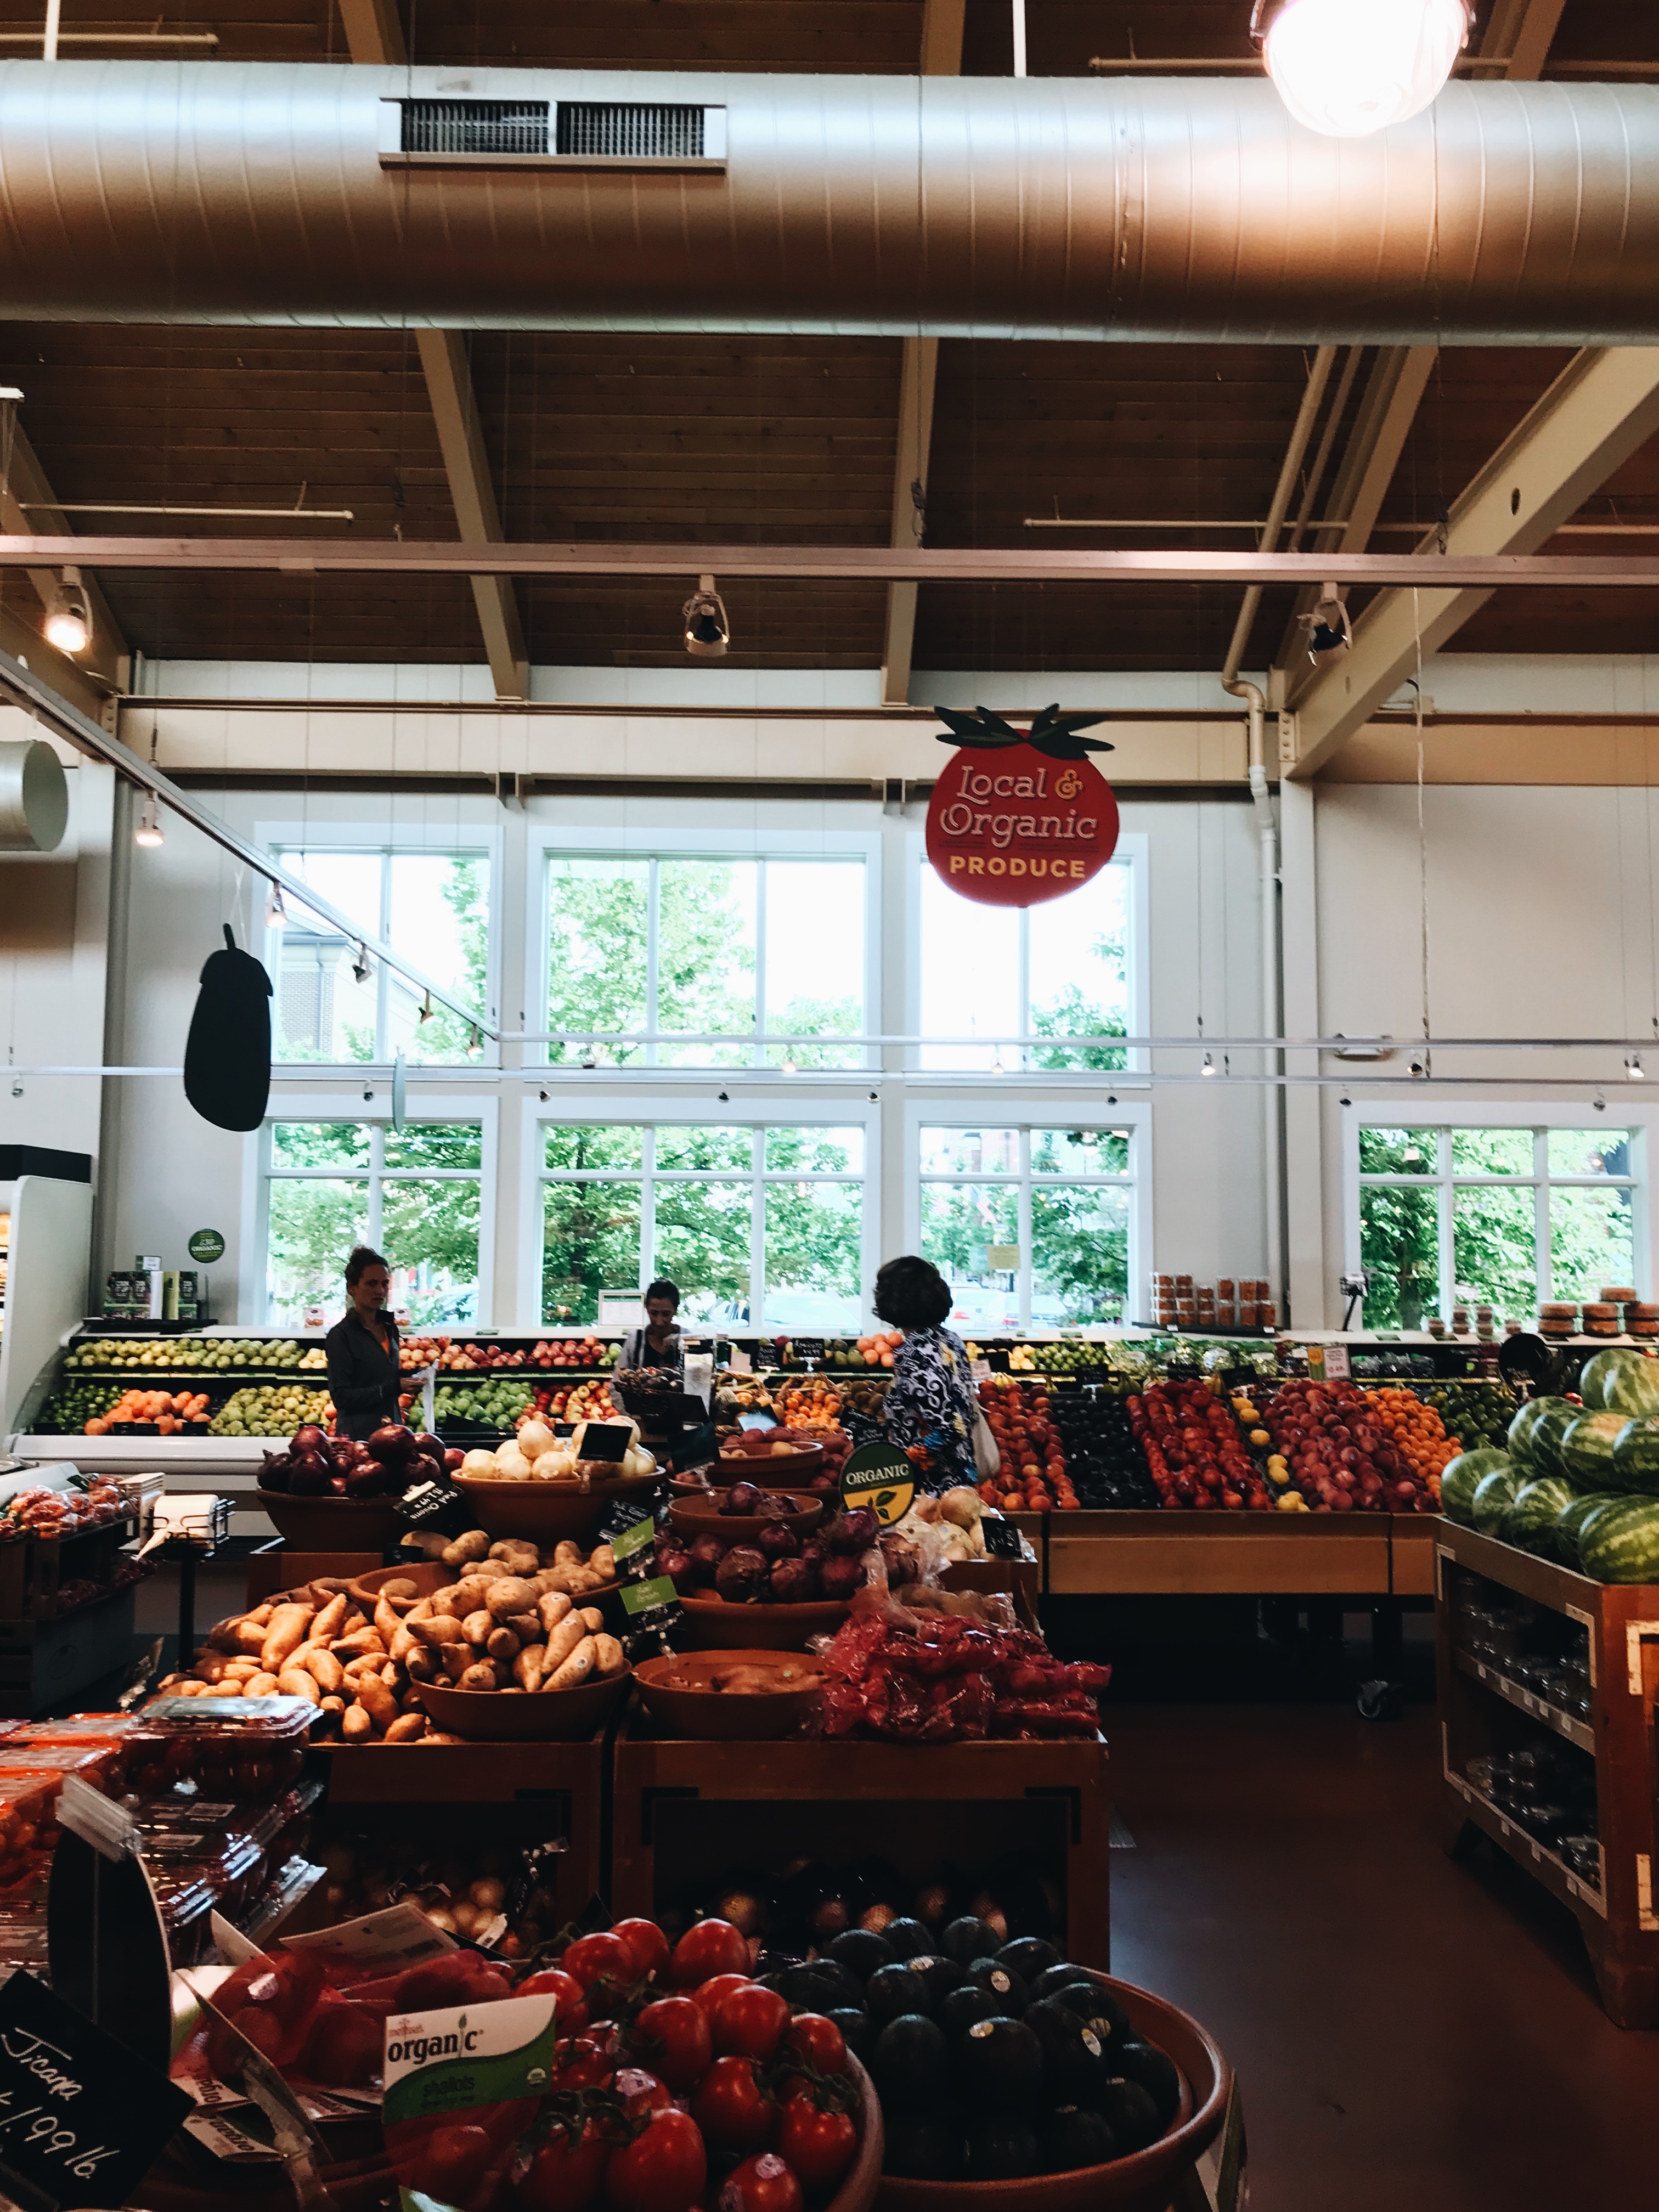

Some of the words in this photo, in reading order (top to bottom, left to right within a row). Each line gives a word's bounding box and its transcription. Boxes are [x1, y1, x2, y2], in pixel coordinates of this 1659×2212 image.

[956, 765, 1048, 805] Local
[1054, 769, 1084, 800] &
[939, 803, 1098, 848] Organic
[949, 855, 1086, 878] PRODUCE
[845, 1463, 910, 1485] ORGANIC
[388, 2023, 478, 2064] organic
